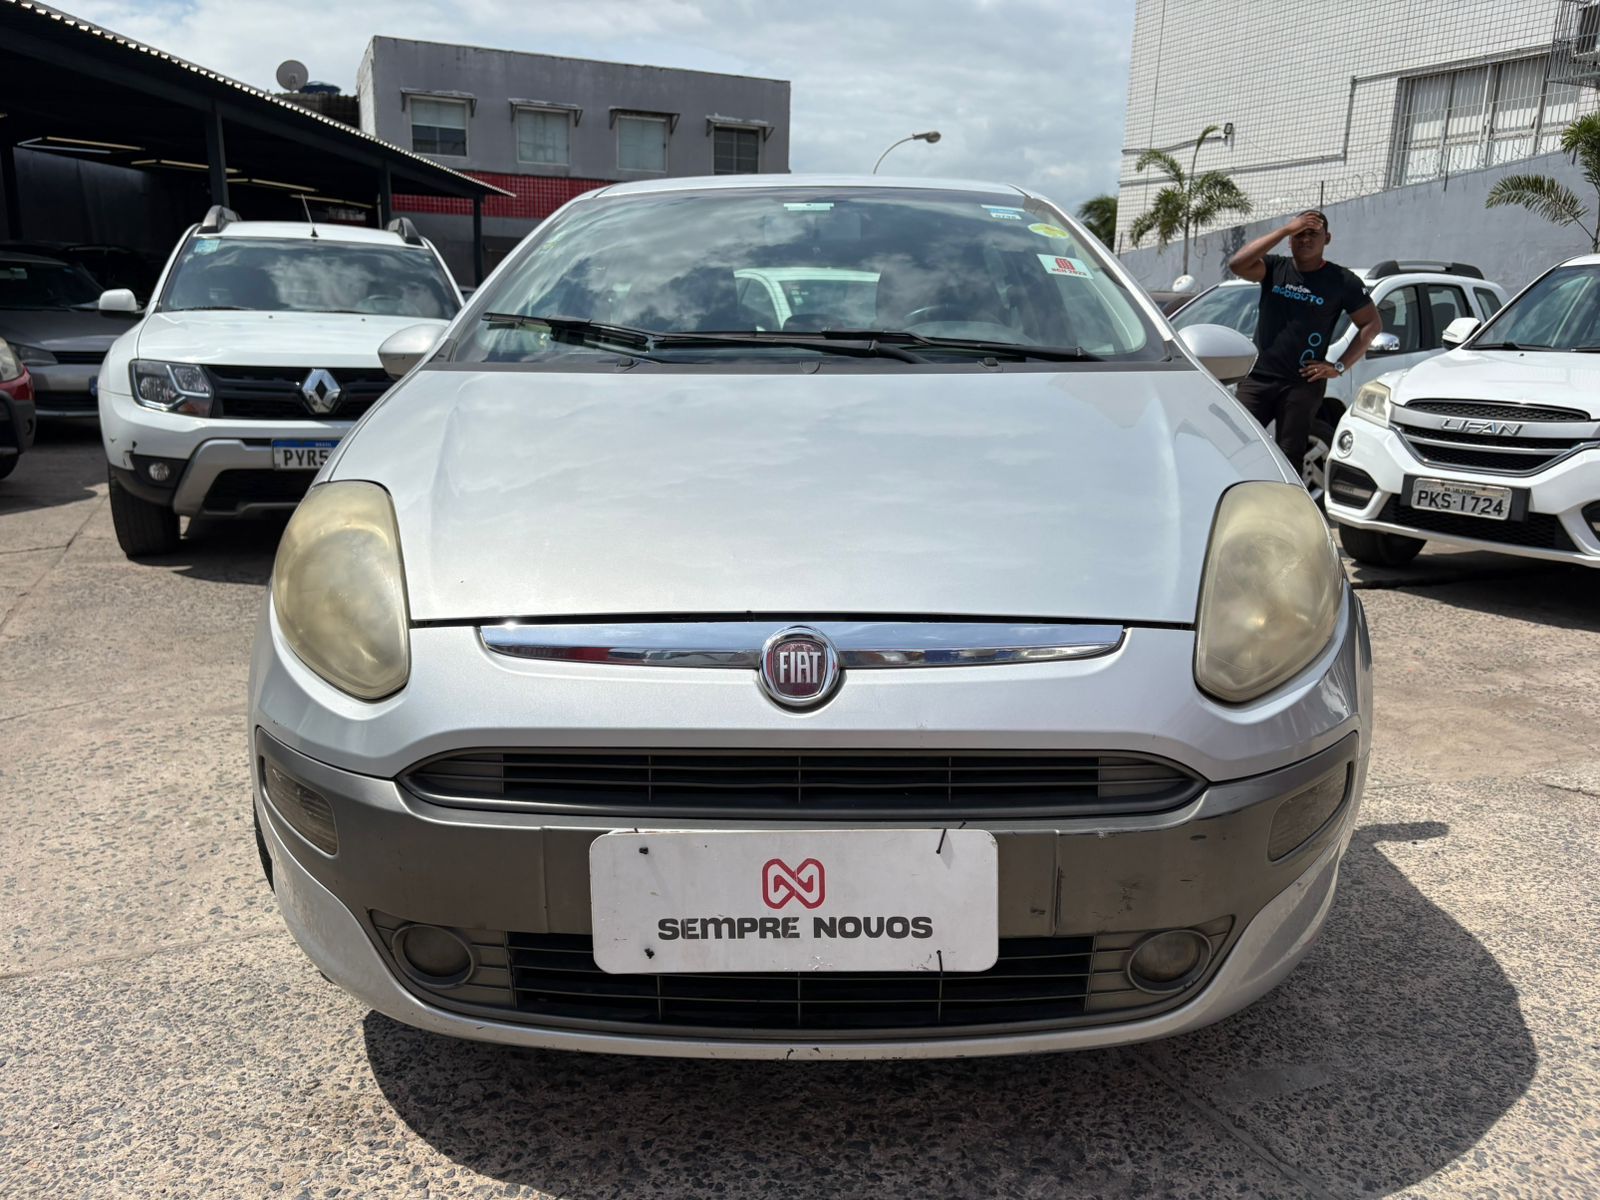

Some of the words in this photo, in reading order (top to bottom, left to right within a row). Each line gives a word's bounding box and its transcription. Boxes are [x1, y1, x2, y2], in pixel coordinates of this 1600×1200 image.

[1441, 419, 1523, 436] LIFAN
[780, 652, 821, 683] FIAT
[658, 917, 800, 940] SEMPRE
[813, 916, 933, 939] NOVOS
